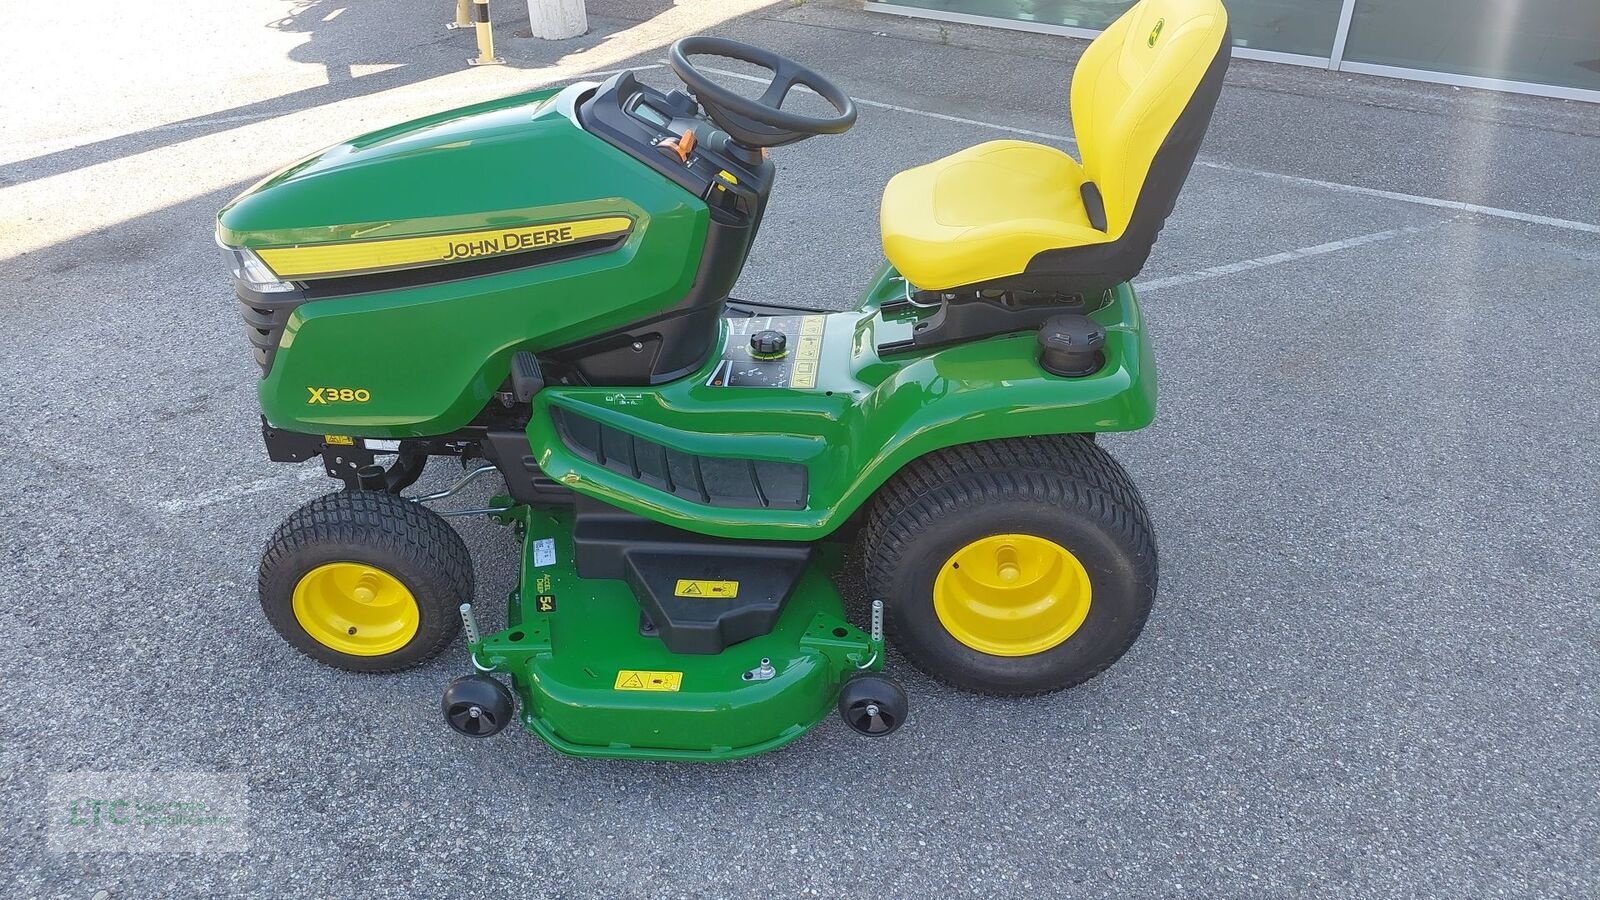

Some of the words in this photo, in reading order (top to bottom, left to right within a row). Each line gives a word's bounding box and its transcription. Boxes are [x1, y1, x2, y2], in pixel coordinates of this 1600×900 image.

[443, 238, 500, 259] JOHN
[503, 226, 573, 250] DEERE
[306, 386, 371, 404] X380
[539, 596, 553, 612] 54
